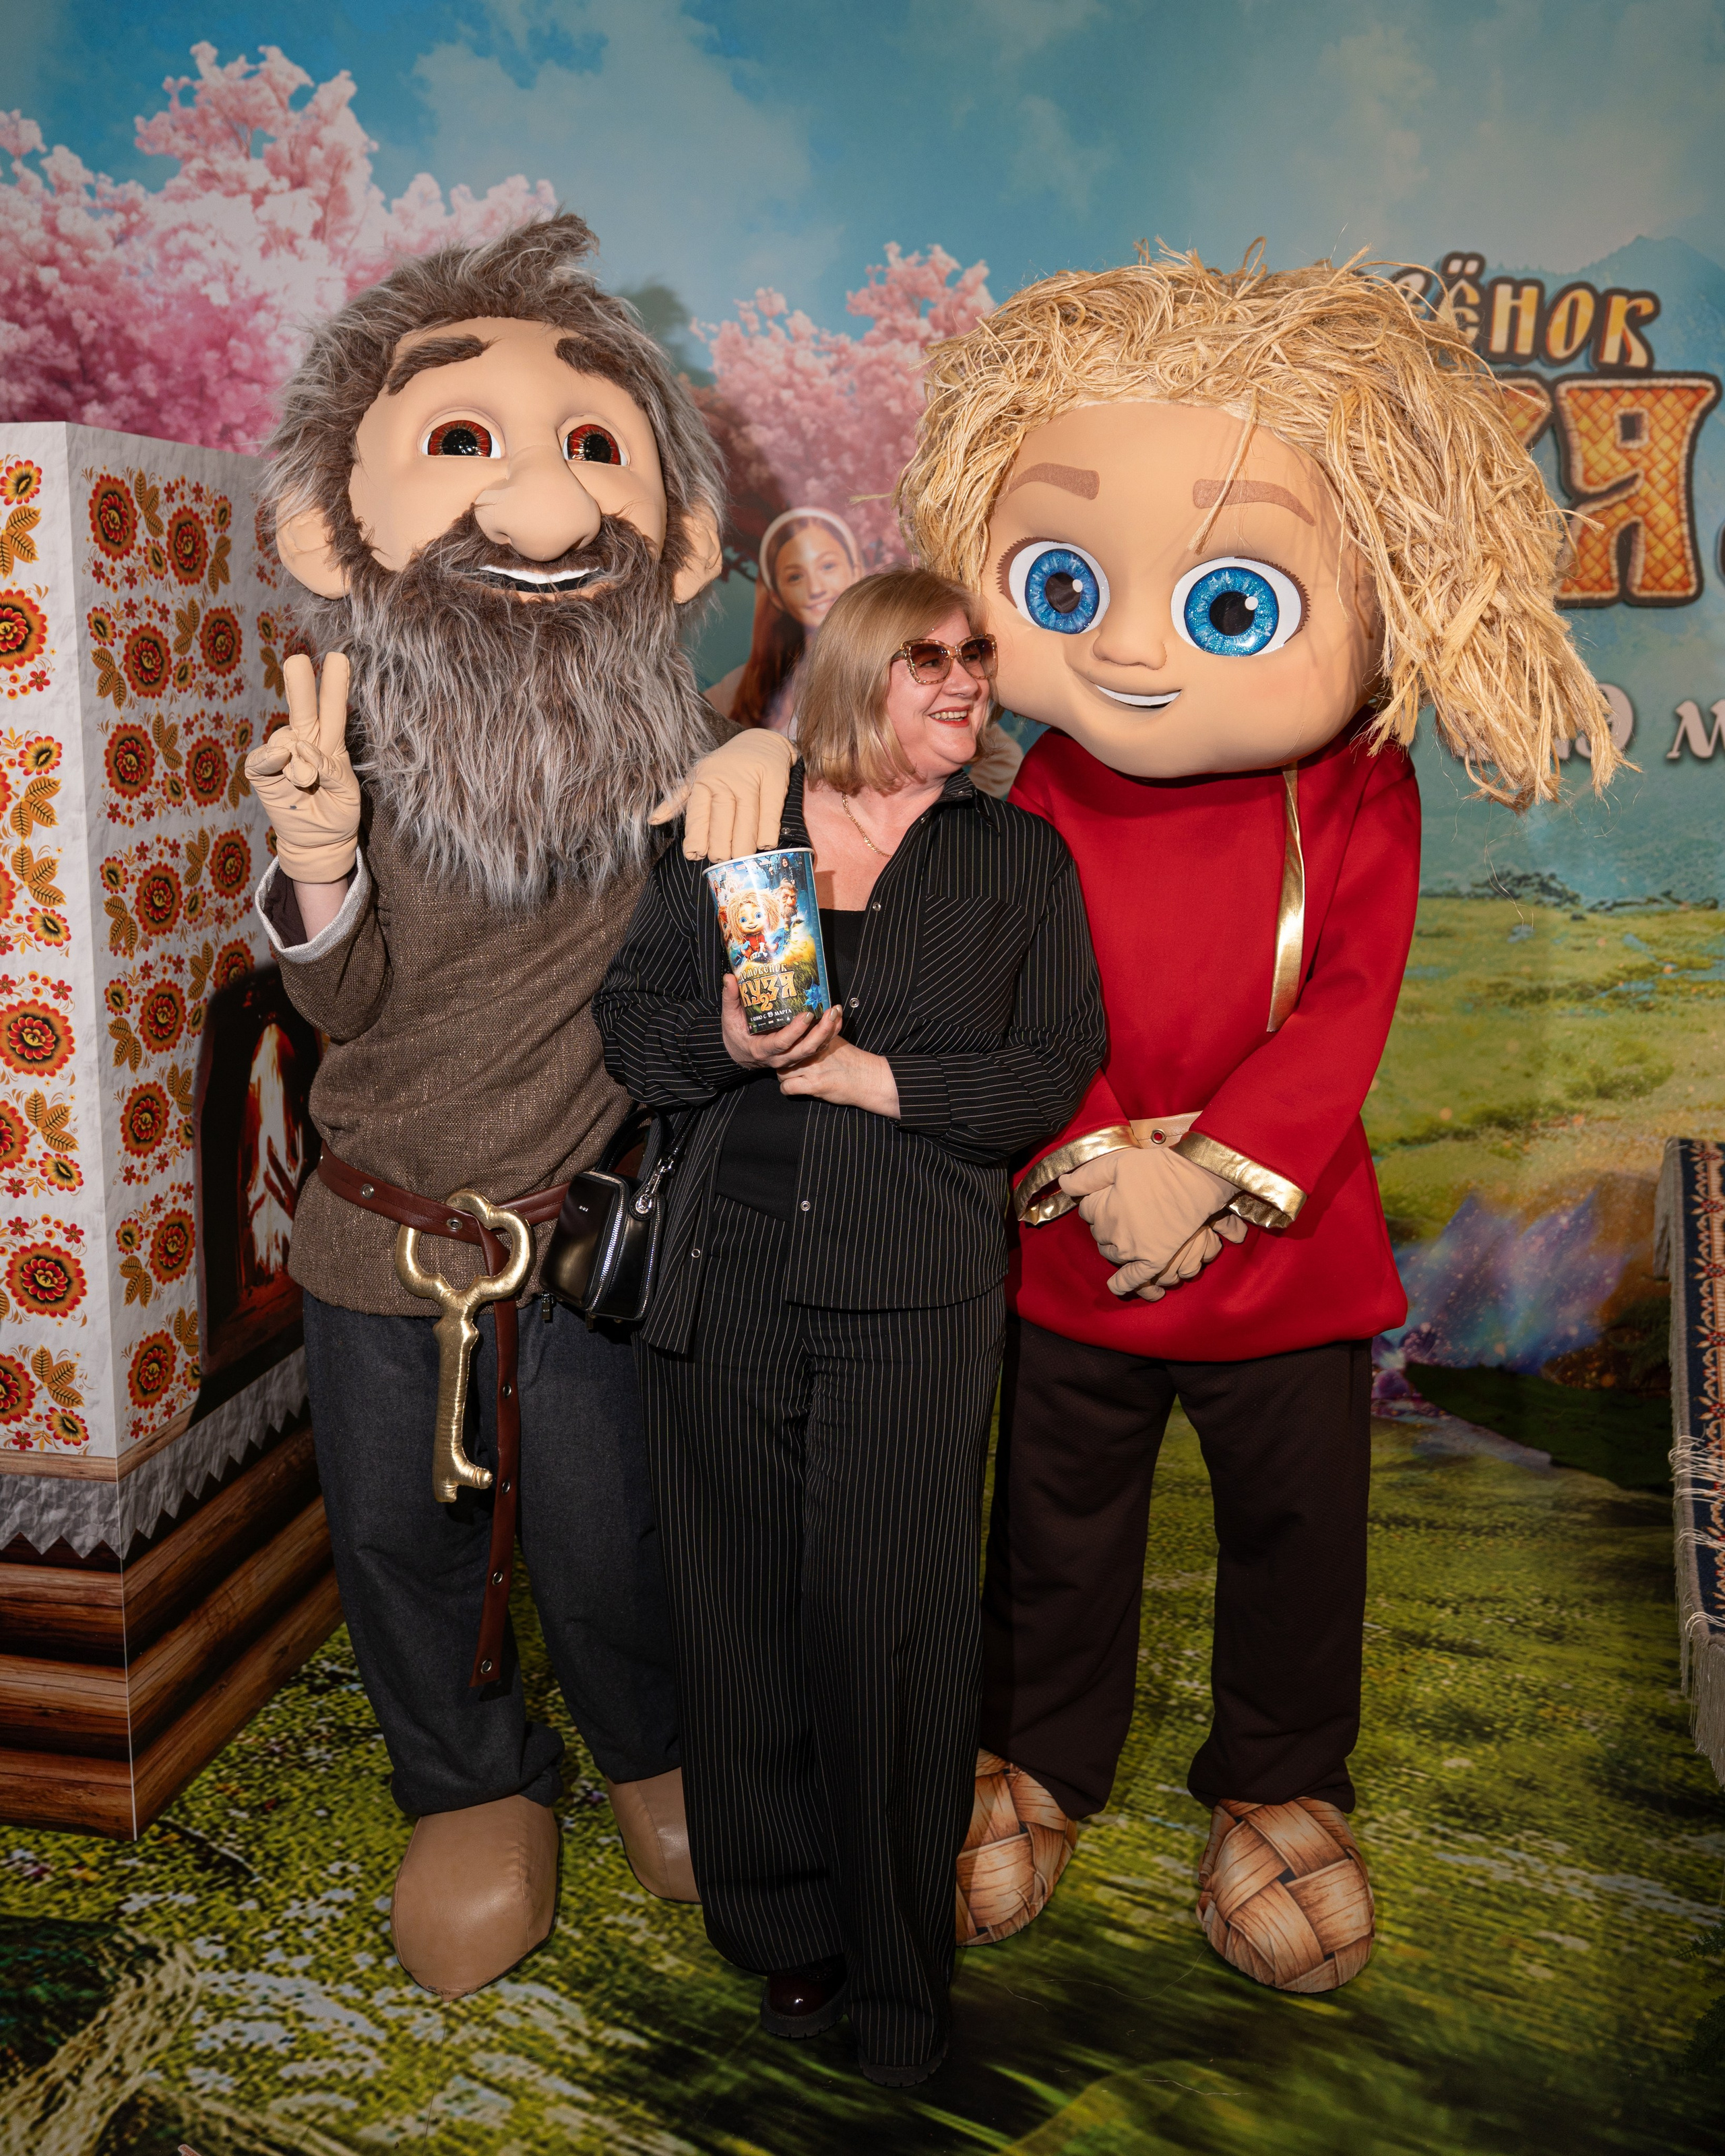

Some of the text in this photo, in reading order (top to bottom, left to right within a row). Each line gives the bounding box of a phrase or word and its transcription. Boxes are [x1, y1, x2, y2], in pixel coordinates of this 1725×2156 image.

[740, 963, 788, 982] ДОМОВЁНОК
[739, 971, 797, 1007] КУЗЯ
[759, 992, 774, 1012] 2
[774, 1009, 792, 1017] МАРТА
